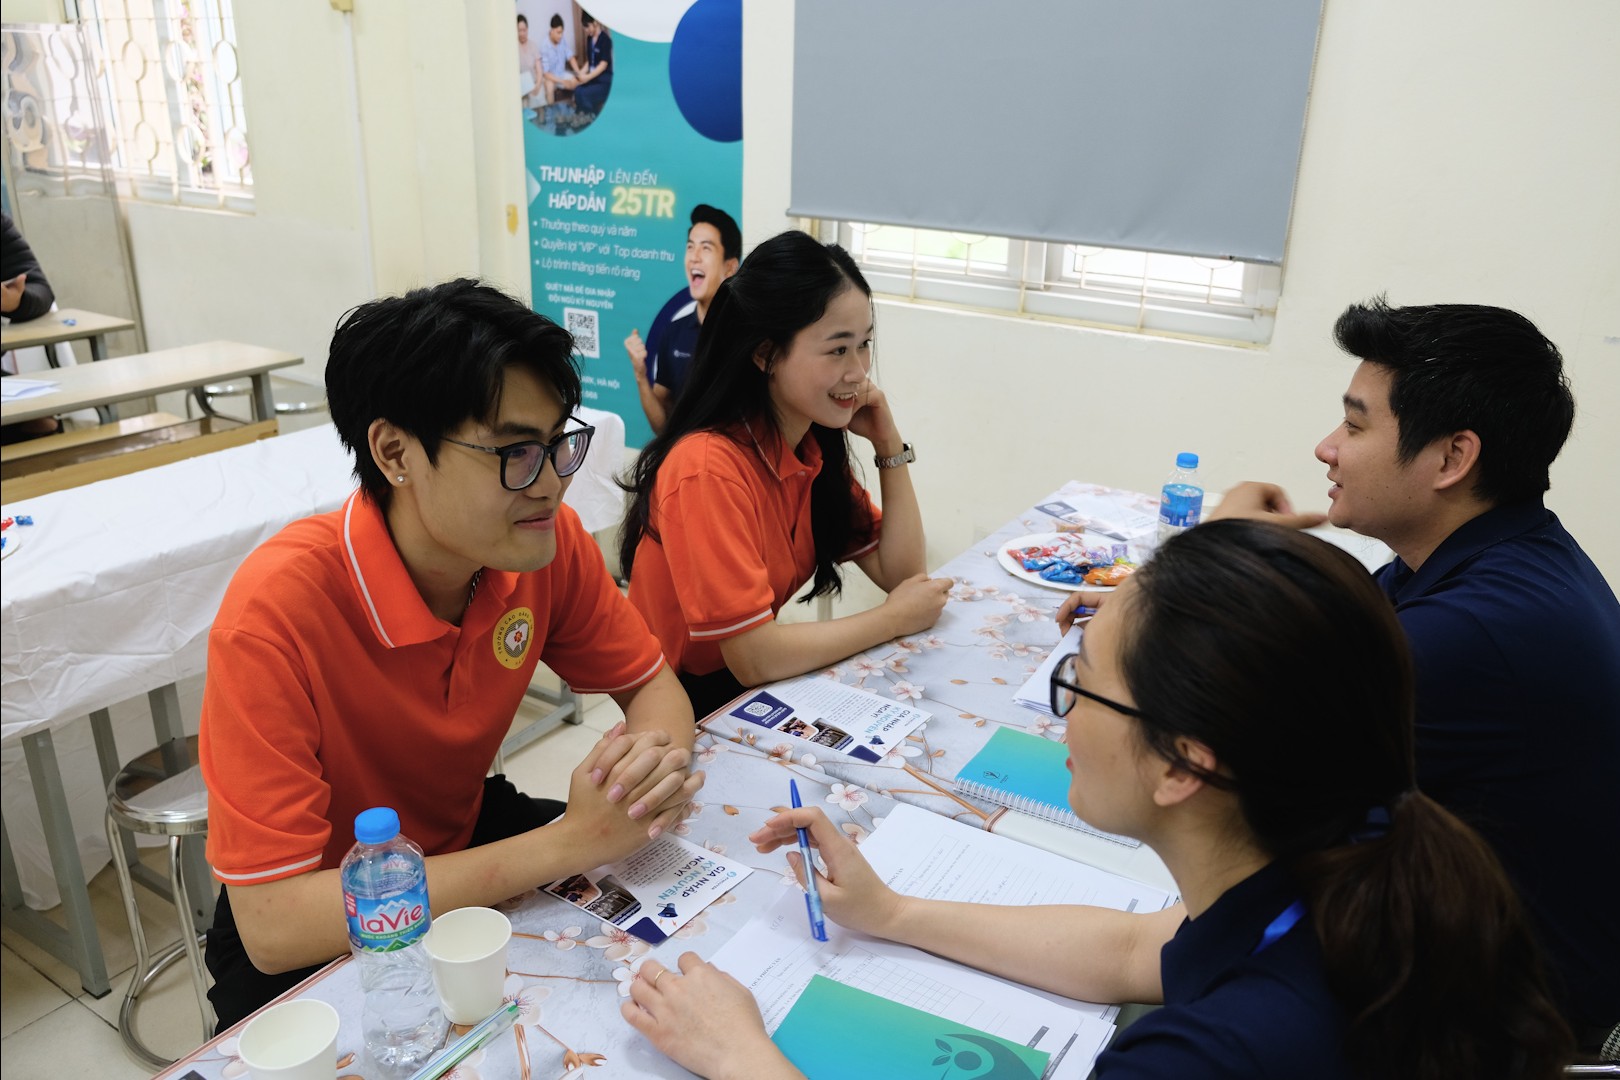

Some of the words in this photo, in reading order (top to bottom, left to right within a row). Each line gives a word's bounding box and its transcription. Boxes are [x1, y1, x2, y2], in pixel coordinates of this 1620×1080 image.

[540, 165, 567, 183] THU
[568, 164, 605, 189] NHẬP
[609, 168, 631, 184] LÊN
[633, 168, 658, 186] ĐẾN
[548, 189, 577, 210] HẤP
[611, 186, 675, 218] 25TR
[571, 221, 590, 233] theo
[606, 224, 618, 236] và
[613, 244, 630, 260] Top
[631, 247, 659, 260] doanh
[660, 250, 675, 262] thu
[504, 614, 516, 624] CAO
[674, 855, 706, 877] NGAY!
[706, 865, 726, 877] GIA
[658, 869, 701, 900] NGUYÊN
[682, 876, 710, 898] NHẬP
